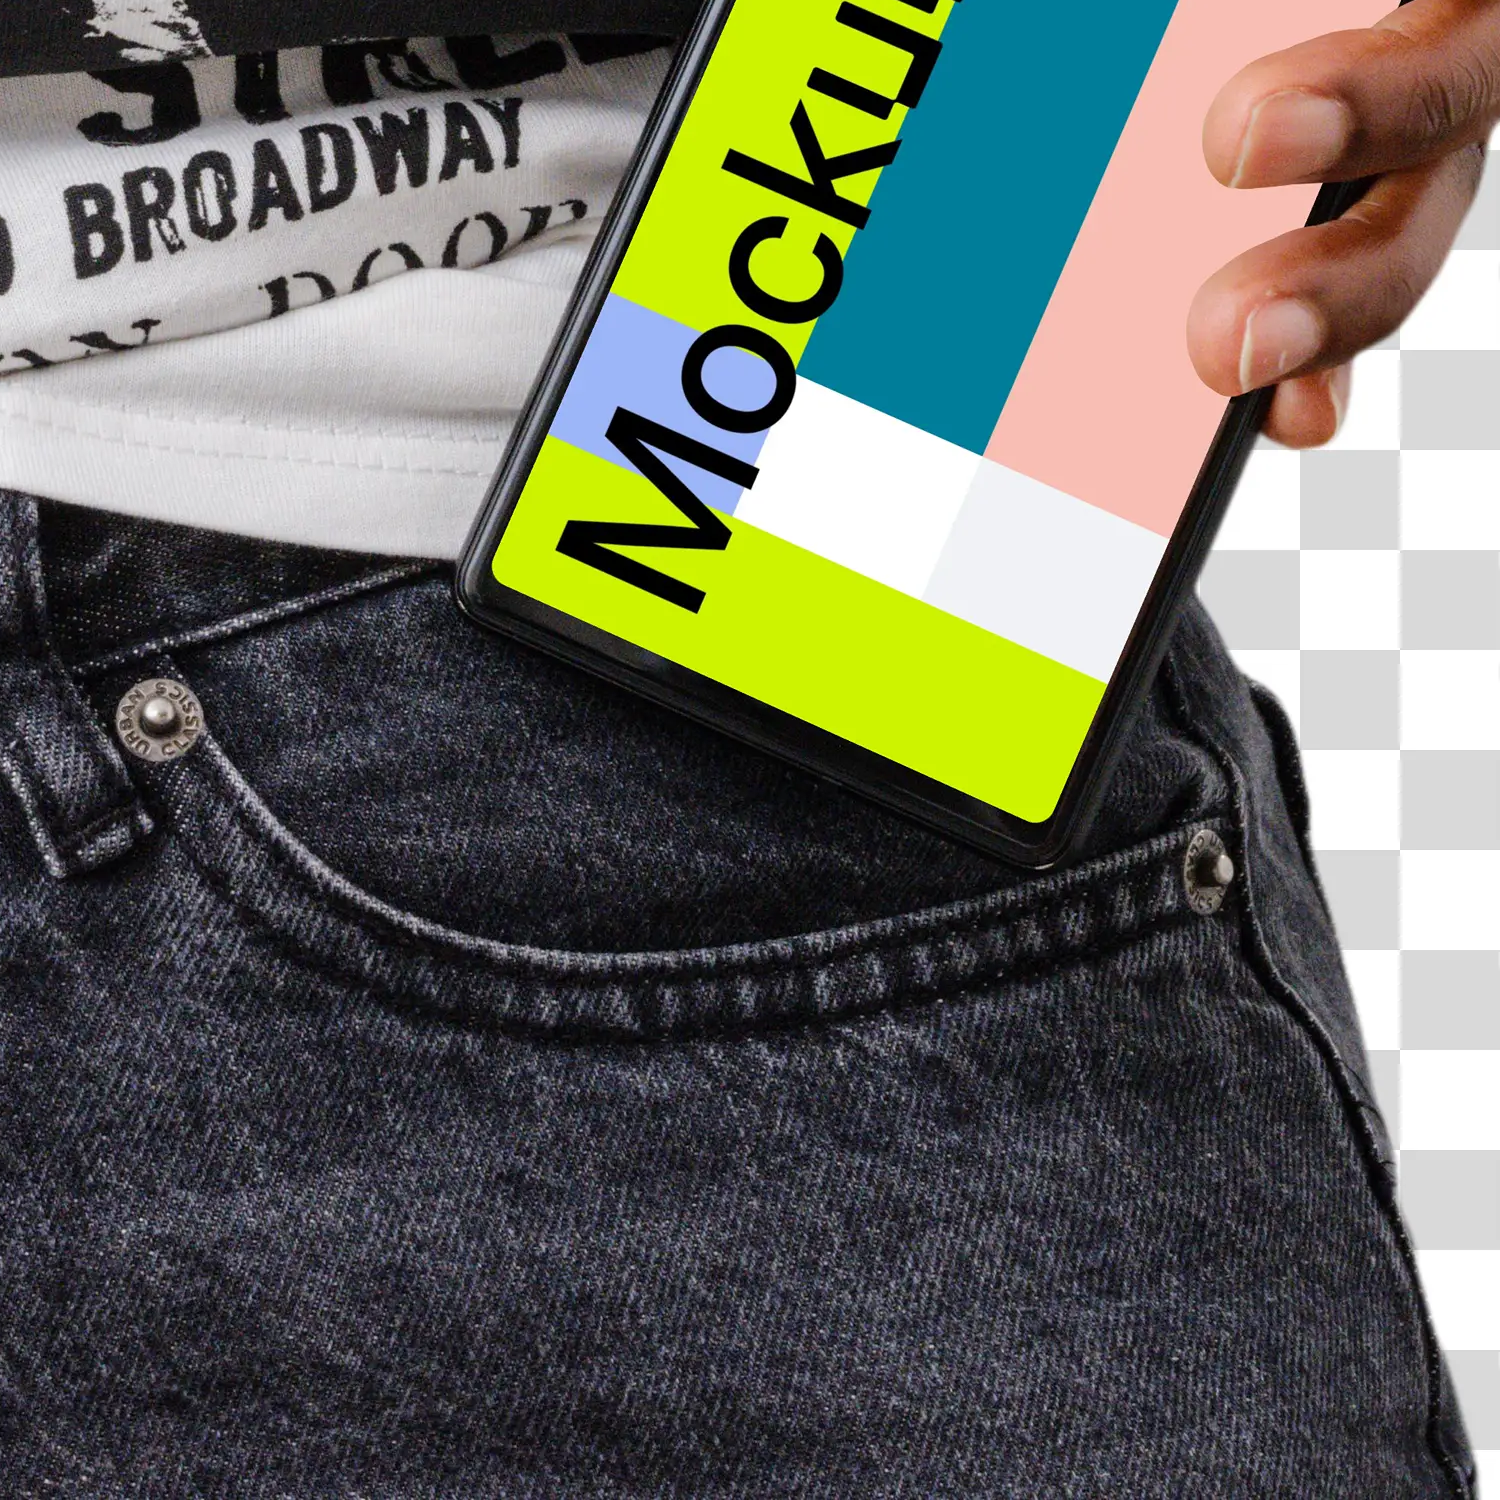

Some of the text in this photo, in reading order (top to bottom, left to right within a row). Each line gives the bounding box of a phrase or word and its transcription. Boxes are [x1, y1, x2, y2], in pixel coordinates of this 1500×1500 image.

[66, 97, 525, 282] BROADWAY
[119, 681, 200, 757] URBAN CLASSICS
